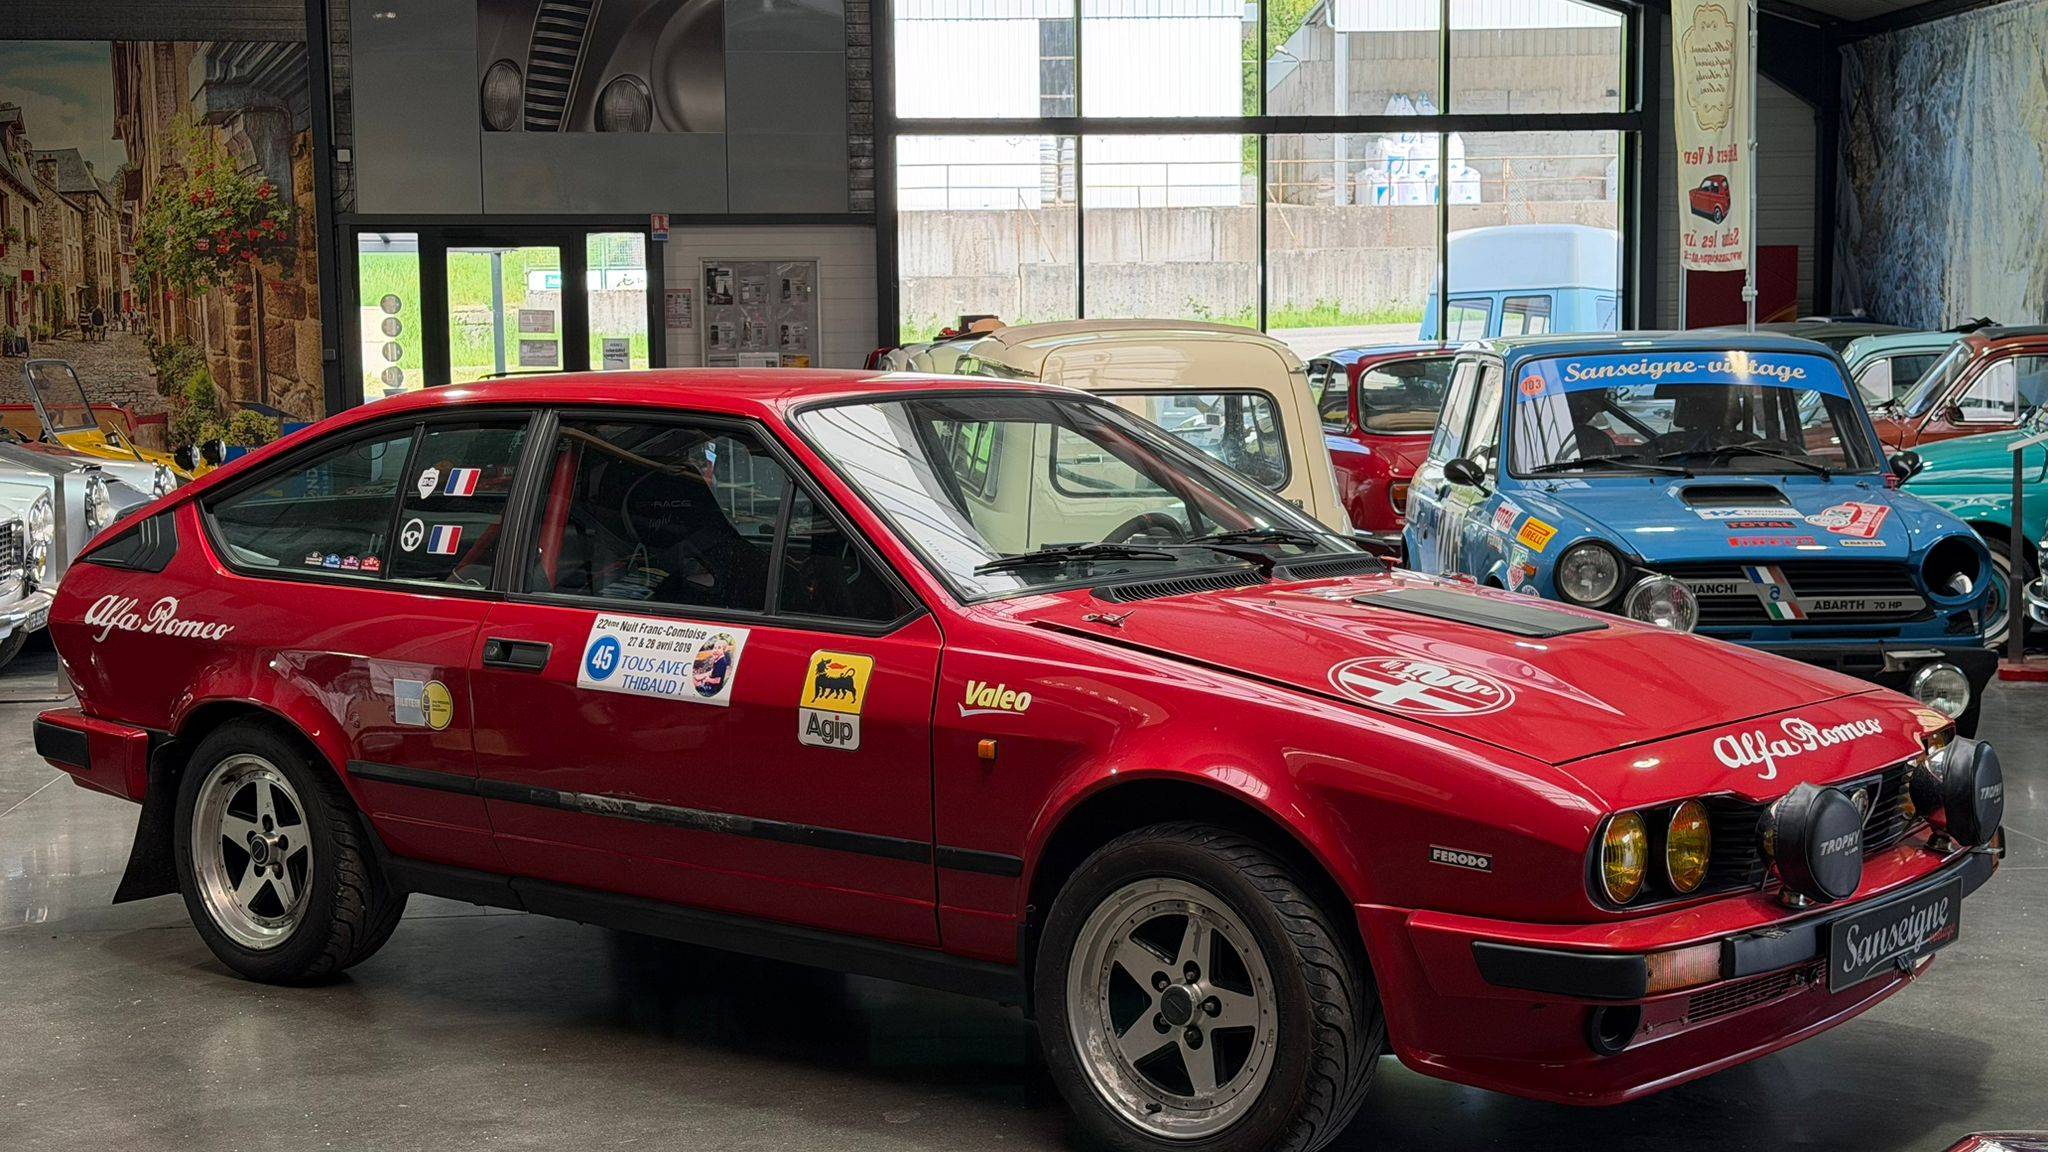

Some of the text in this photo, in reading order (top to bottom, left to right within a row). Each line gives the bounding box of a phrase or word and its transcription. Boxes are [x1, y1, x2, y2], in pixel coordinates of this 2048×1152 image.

[1564, 358, 1807, 384] Sanseigne-vitage
[1523, 379, 1543, 391] 103
[1520, 523, 1552, 545] PIRELLI
[1728, 521, 1795, 529] TOTAL
[1814, 600, 1902, 610] ABARTH 70 HP
[85, 594, 142, 643] Alfa
[141, 596, 235, 640] Romeo
[620, 620, 639, 633] Nuit
[640, 622, 707, 640] Franc-Comtoise
[627, 636, 692, 653] 27 & 28 avril 2019
[592, 645, 615, 670] 45
[621, 655, 692, 677] TOUS AVEC
[622, 674, 685, 696] THIBAUD !
[965, 679, 1033, 712] Valeo
[805, 711, 854, 746] Agip
[1713, 717, 1883, 780] Alfa Romeo
[1820, 829, 1861, 856] TROPHY
[1433, 849, 1488, 868] FERODO
[1843, 896, 1949, 973] Sanseigne
